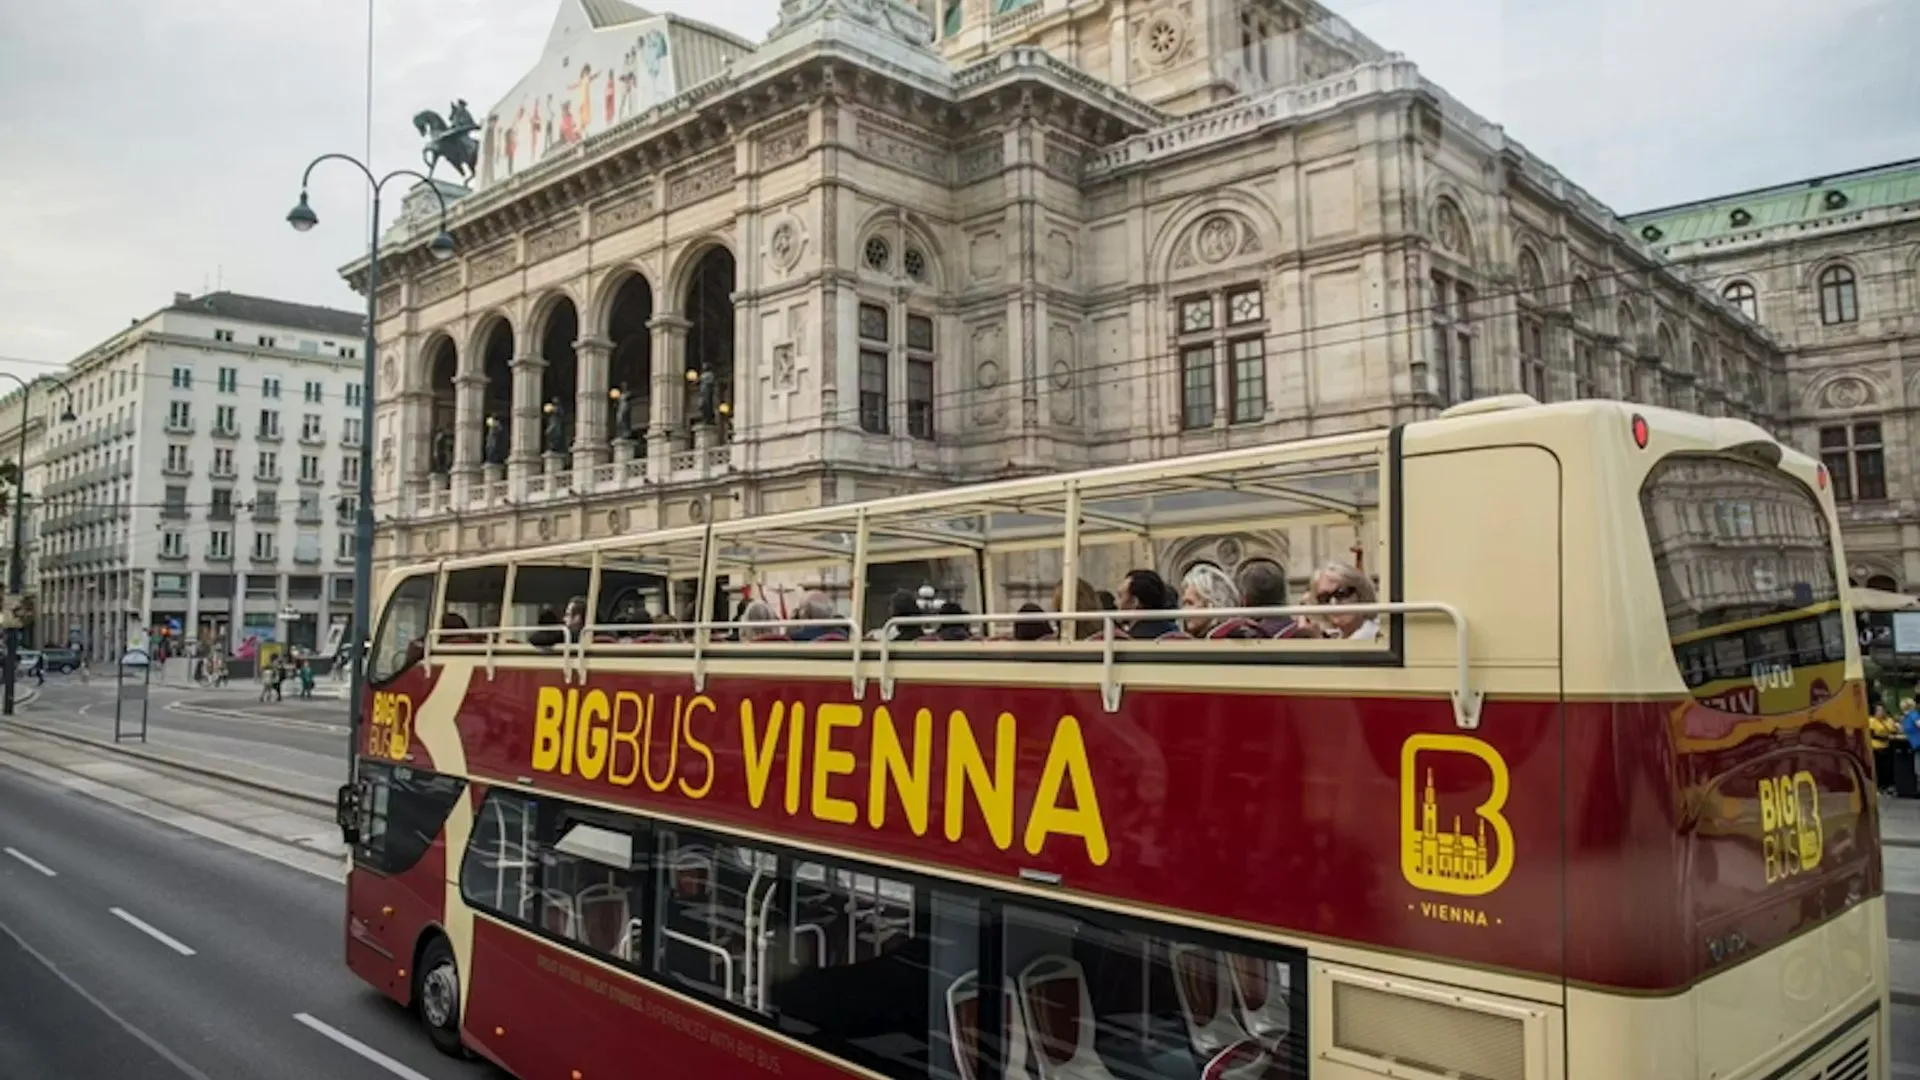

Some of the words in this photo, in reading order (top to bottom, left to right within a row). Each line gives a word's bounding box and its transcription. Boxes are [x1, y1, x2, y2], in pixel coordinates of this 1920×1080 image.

[373, 691, 396, 726] BIG
[741, 698, 1108, 866] VIENNA
[1759, 775, 1795, 832] BIG
[1763, 829, 1800, 884] BUS
[1420, 901, 1489, 926] VIENNA
